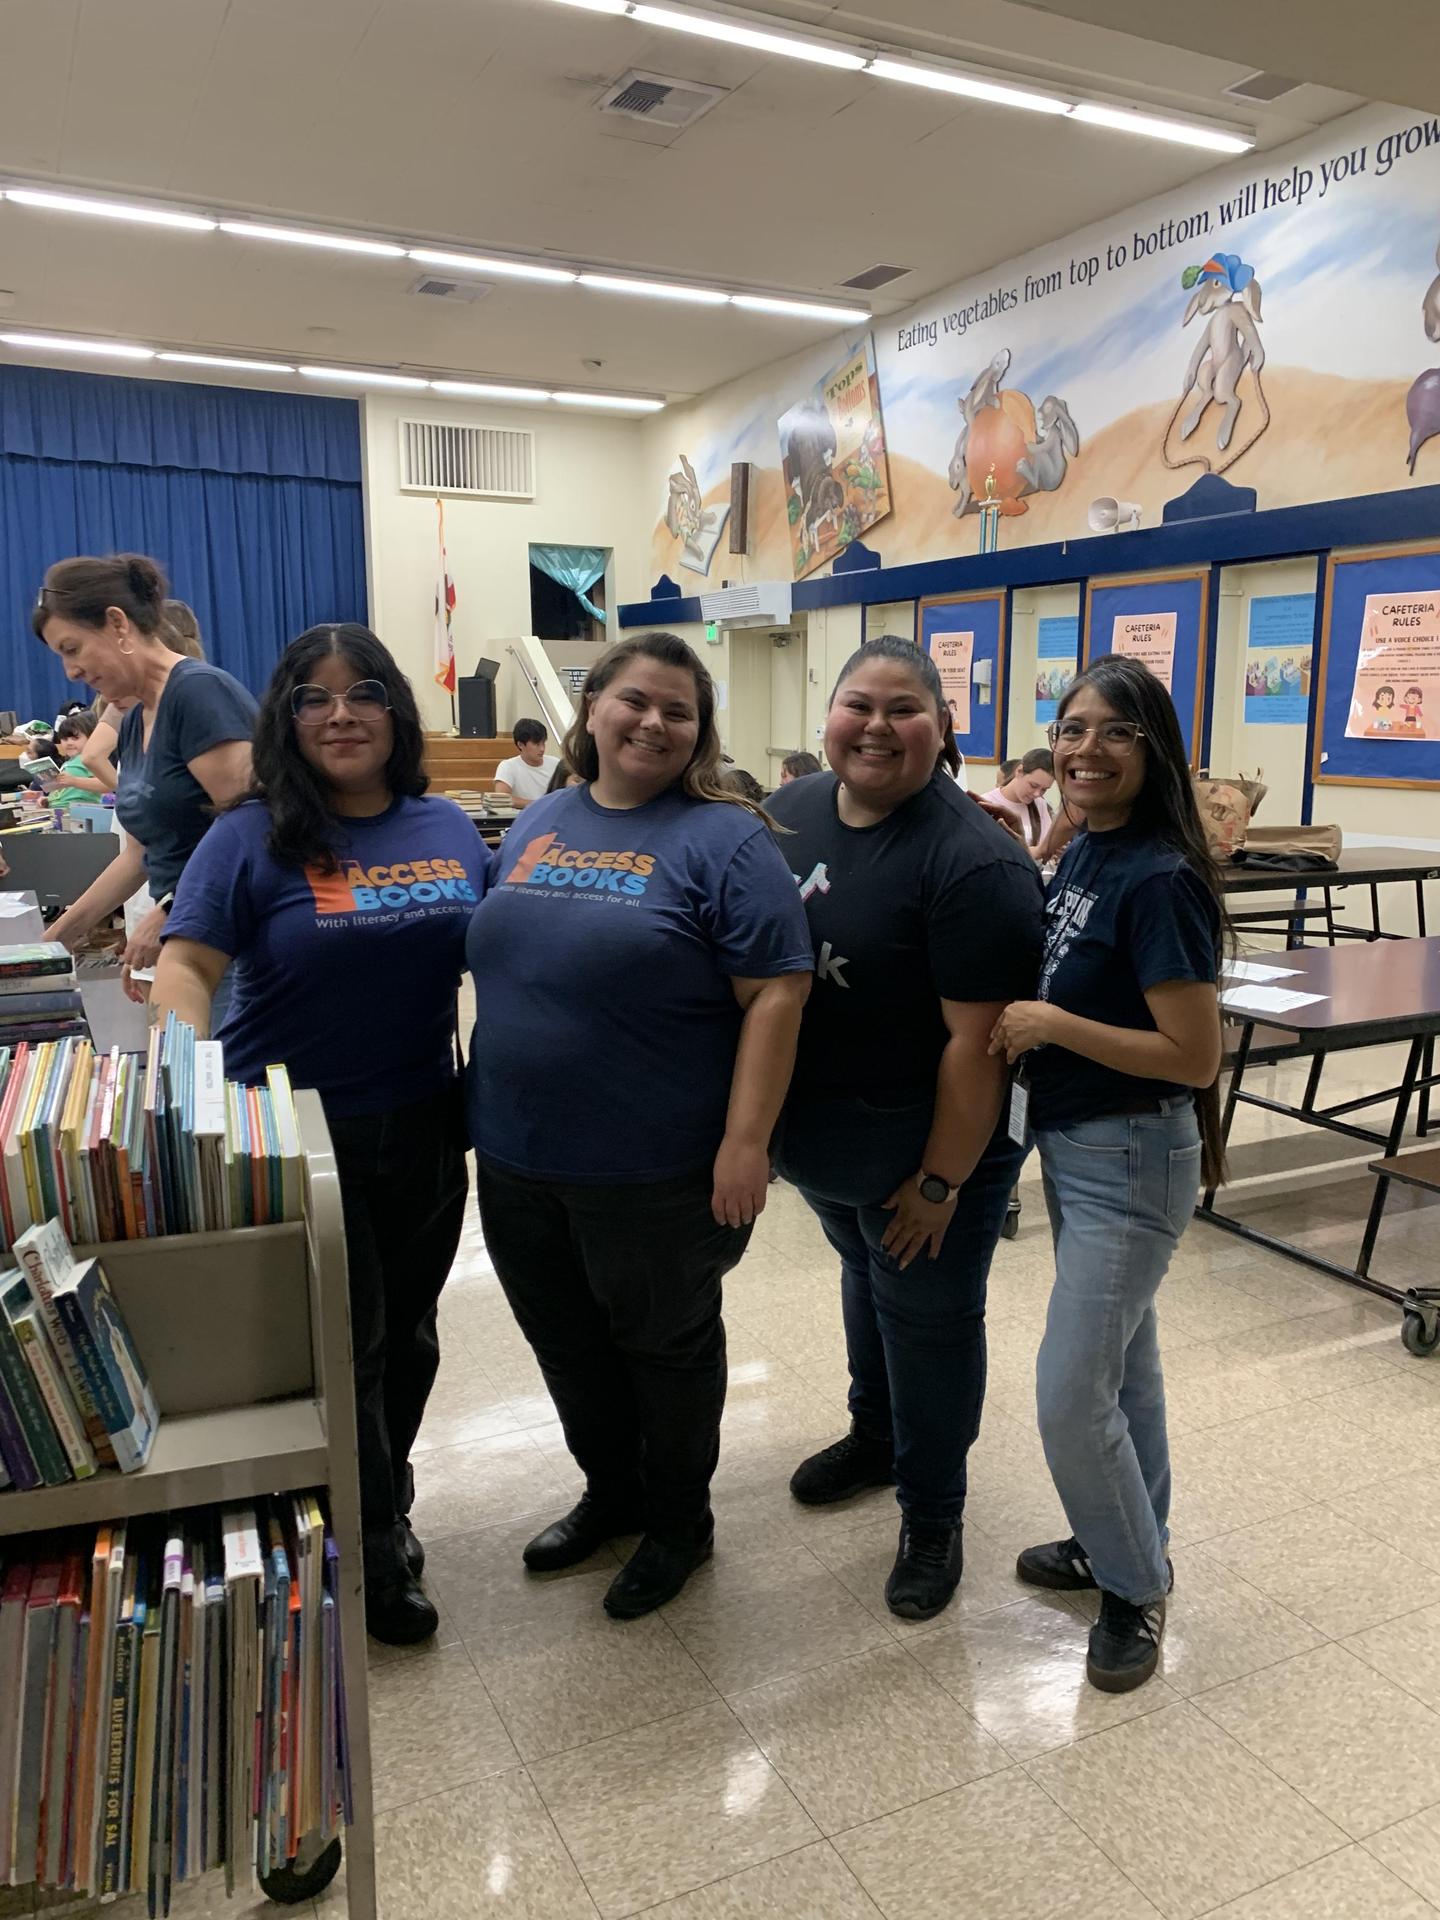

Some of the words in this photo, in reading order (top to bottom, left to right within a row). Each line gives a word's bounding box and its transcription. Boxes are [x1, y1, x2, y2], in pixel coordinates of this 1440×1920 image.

[898, 321, 938, 352] Eating
[942, 289, 1018, 336] vegetables
[1024, 270, 1063, 303] from
[1069, 256, 1100, 287] top
[1106, 244, 1127, 271] to
[1132, 210, 1214, 261] bottom,
[1219, 182, 1258, 226] will
[1262, 166, 1314, 210] help
[1319, 146, 1368, 198] you
[1374, 119, 1440, 176] grow
[826, 361, 863, 401] Tops
[1382, 603, 1435, 616] CAFETERIA
[1392, 617, 1421, 627] RULES
[1125, 623, 1161, 633] CAFETERIA
[1132, 634, 1152, 642] RULES
[938, 640, 963, 648] CAFETERIA
[347, 858, 467, 888] ACCESS
[536, 848, 657, 876] ACCESS
[527, 864, 649, 896] BOOKS
[351, 879, 478, 911] BOOKS
[572, 892, 604, 901] access
[606, 895, 623, 904] for
[625, 899, 640, 908] all
[315, 917, 348, 929] With
[353, 912, 400, 926] literacy
[403, 908, 426, 919] and
[108, 1697, 125, 1785] BLUEBERRIES
[106, 1790, 119, 1818] FOR
[105, 1823, 118, 1848] SAL
